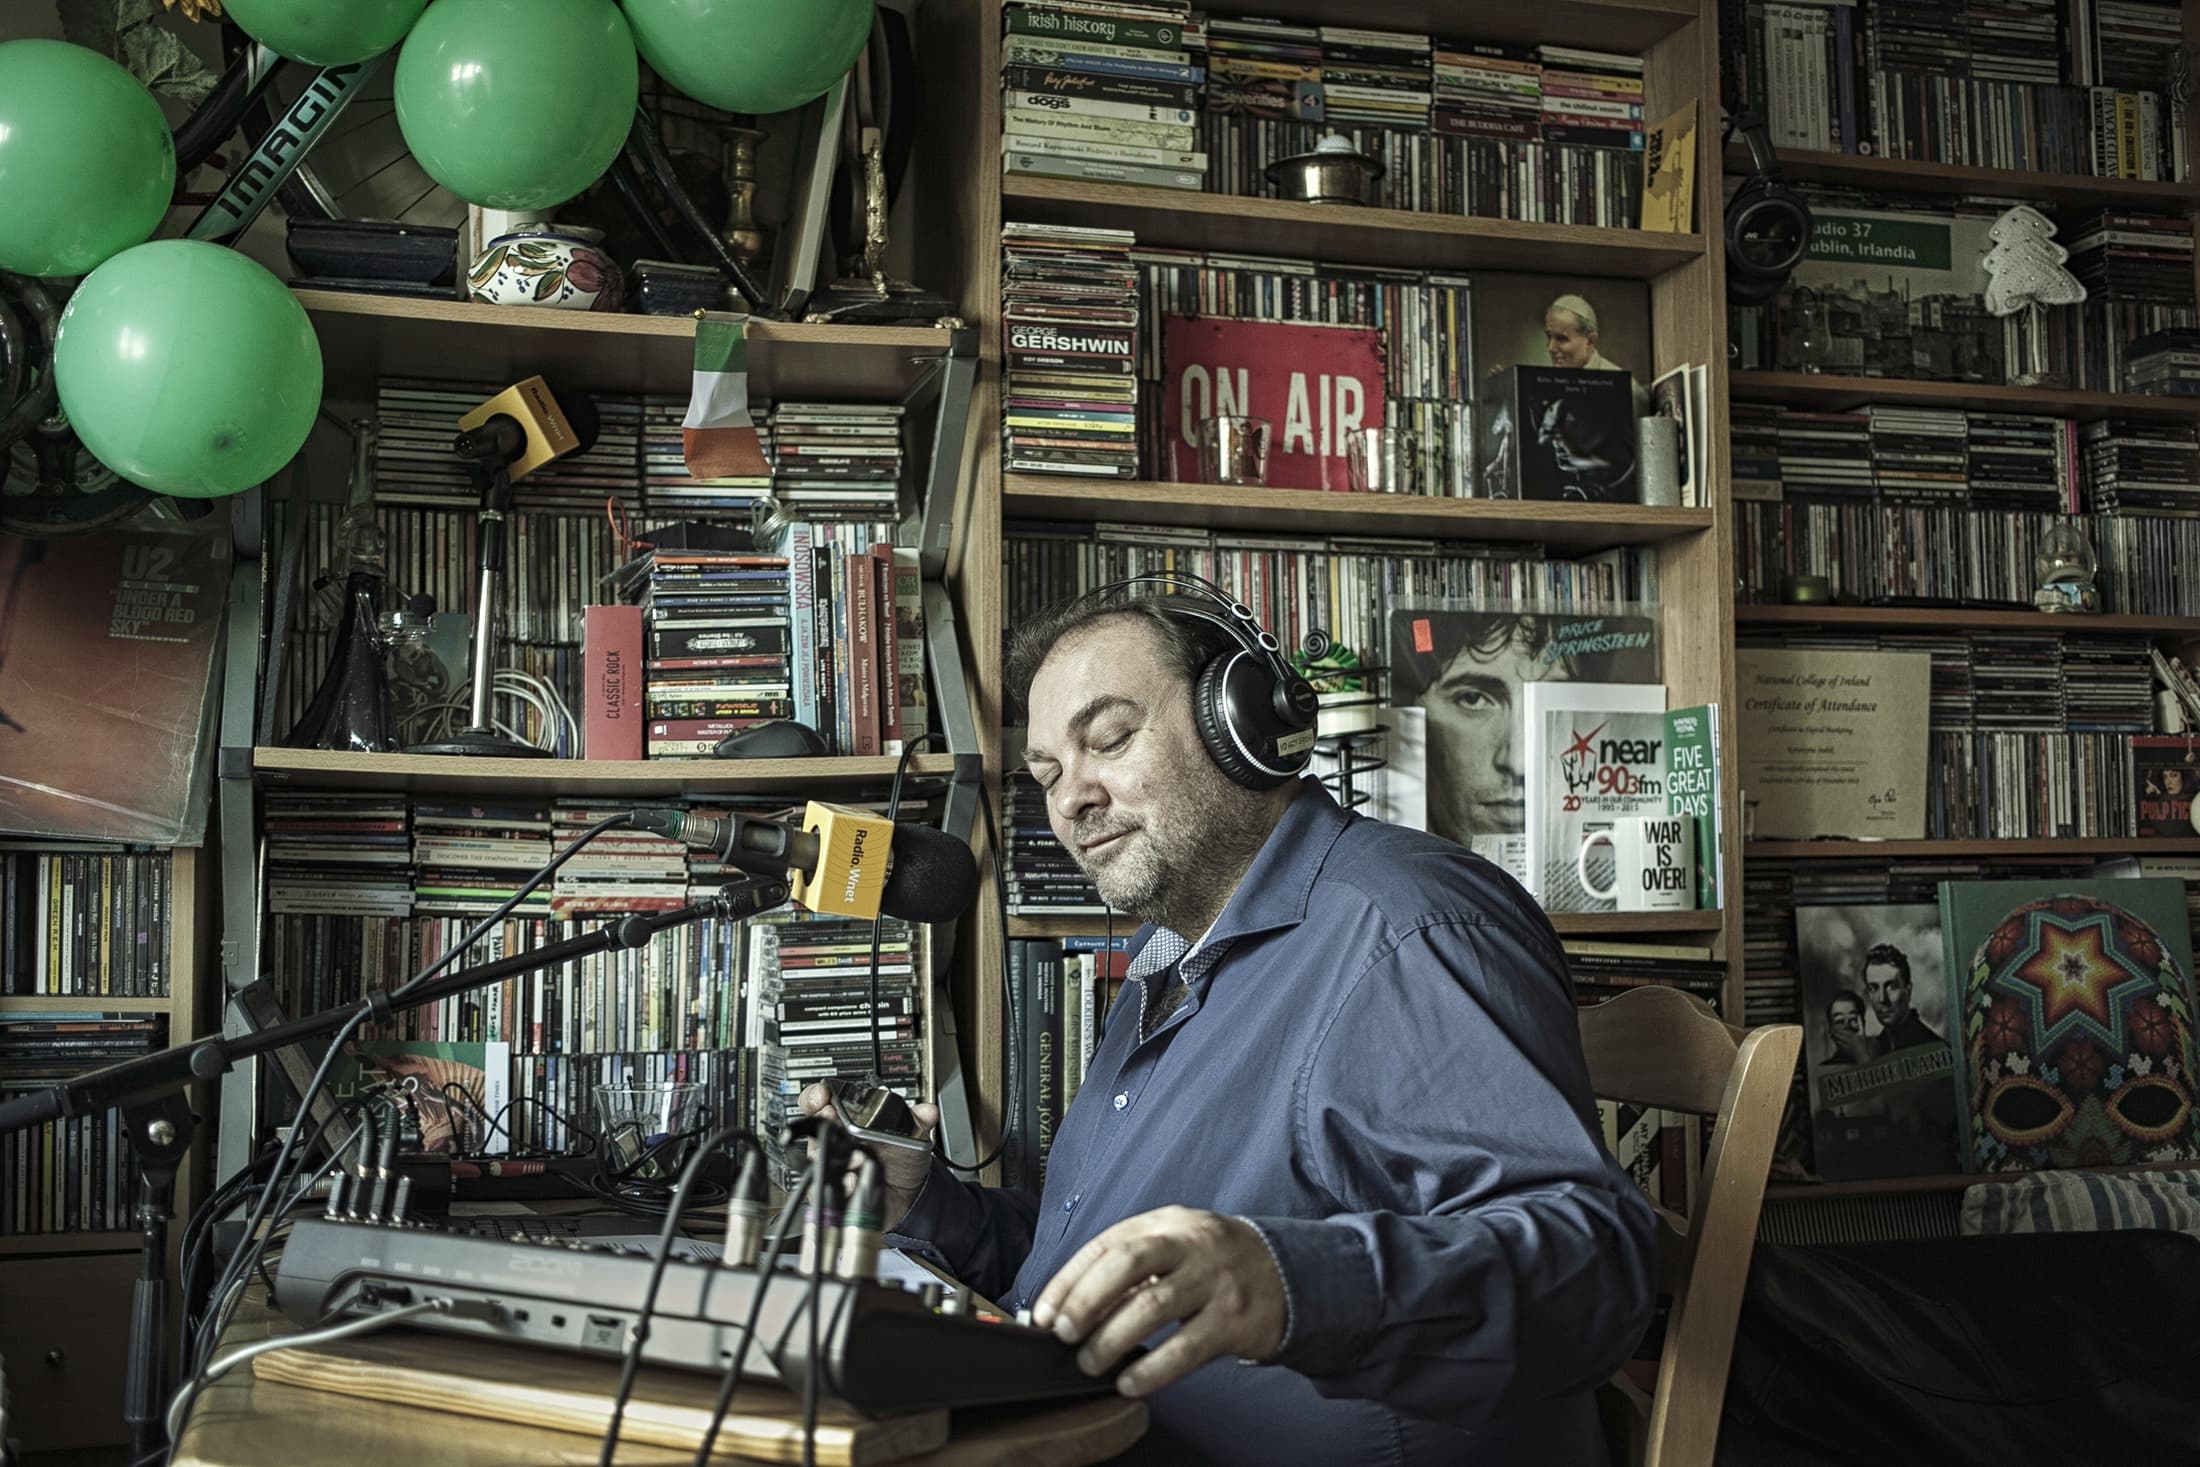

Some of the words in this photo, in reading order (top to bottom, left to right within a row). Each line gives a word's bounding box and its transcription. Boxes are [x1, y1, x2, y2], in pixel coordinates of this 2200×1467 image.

[1179, 67, 1190, 78] 2
[1028, 94, 1071, 109] dogs
[218, 61, 362, 220] IMAGIN
[1852, 225, 1872, 241] 37
[1810, 241, 1854, 257] ublin,
[1858, 245, 1916, 260] Irlandia
[1011, 325, 1058, 337] GEORGE
[1011, 334, 1129, 355] GERSHWIN
[1181, 362, 1249, 449] ON
[1283, 371, 1365, 458] AIR
[121, 543, 174, 583] U2
[794, 533, 812, 610] NOSOWSKA
[170, 591, 182, 608] A
[112, 604, 161, 622] BLOOD
[163, 606, 195, 623] RED
[109, 619, 151, 635] SKY"
[1558, 618, 1604, 641] BRUCE
[1542, 631, 1650, 665] SPRINGSTEEN
[606, 650, 621, 675] ROCK
[1756, 675, 1795, 689] National
[1796, 675, 1827, 691] College
[1828, 675, 1839, 691] of
[1840, 675, 1871, 689] Ireland
[606, 679, 621, 720] CLASSIC
[1745, 698, 1800, 715] Certificate
[1803, 698, 1818, 716] of
[1820, 698, 1878, 714] Attendance
[1599, 740, 1663, 764] near
[1673, 744, 1704, 770] FIVE
[1666, 768, 1713, 796] GREAT
[1562, 795, 1582, 813] 20
[1673, 793, 1709, 818] DAYS
[2140, 800, 2170, 821] PULP
[1645, 821, 1682, 845] WAR
[1656, 844, 1672, 867] IS
[1642, 867, 1687, 891] OVER!
[858, 1000, 890, 1011] chin
[1084, 987, 1094, 1045] TOLKIEN'S
[1039, 1031, 1053, 1104] GENERAŁ
[1825, 1063, 1899, 1099] MERRIE
[1037, 1104, 1056, 1152] JÓZEF
